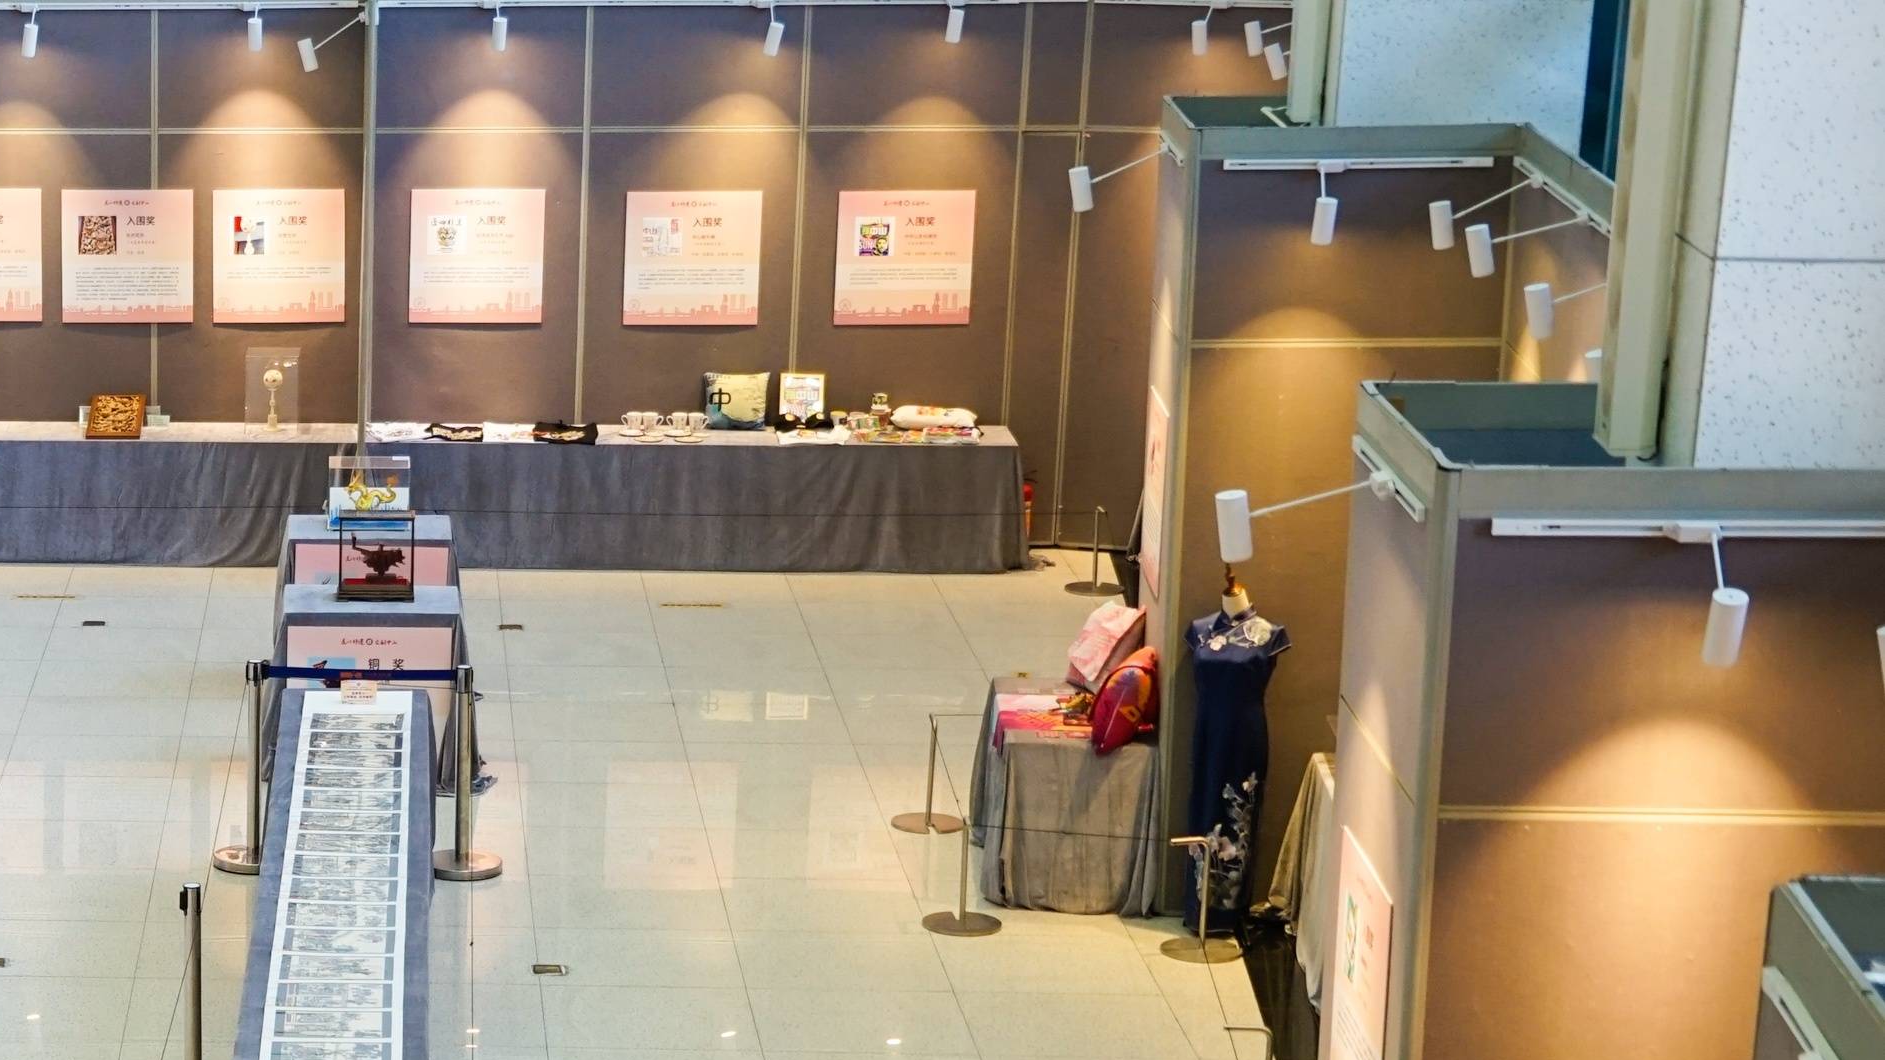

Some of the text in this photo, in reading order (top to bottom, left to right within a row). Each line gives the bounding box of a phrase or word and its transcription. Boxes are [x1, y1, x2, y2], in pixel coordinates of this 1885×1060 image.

[126, 216, 155, 226] 入围奖
[692, 217, 723, 227] 入围奖
[905, 216, 936, 227] 入围奖
[709, 388, 731, 411] 中
[392, 658, 405, 671] 奖
